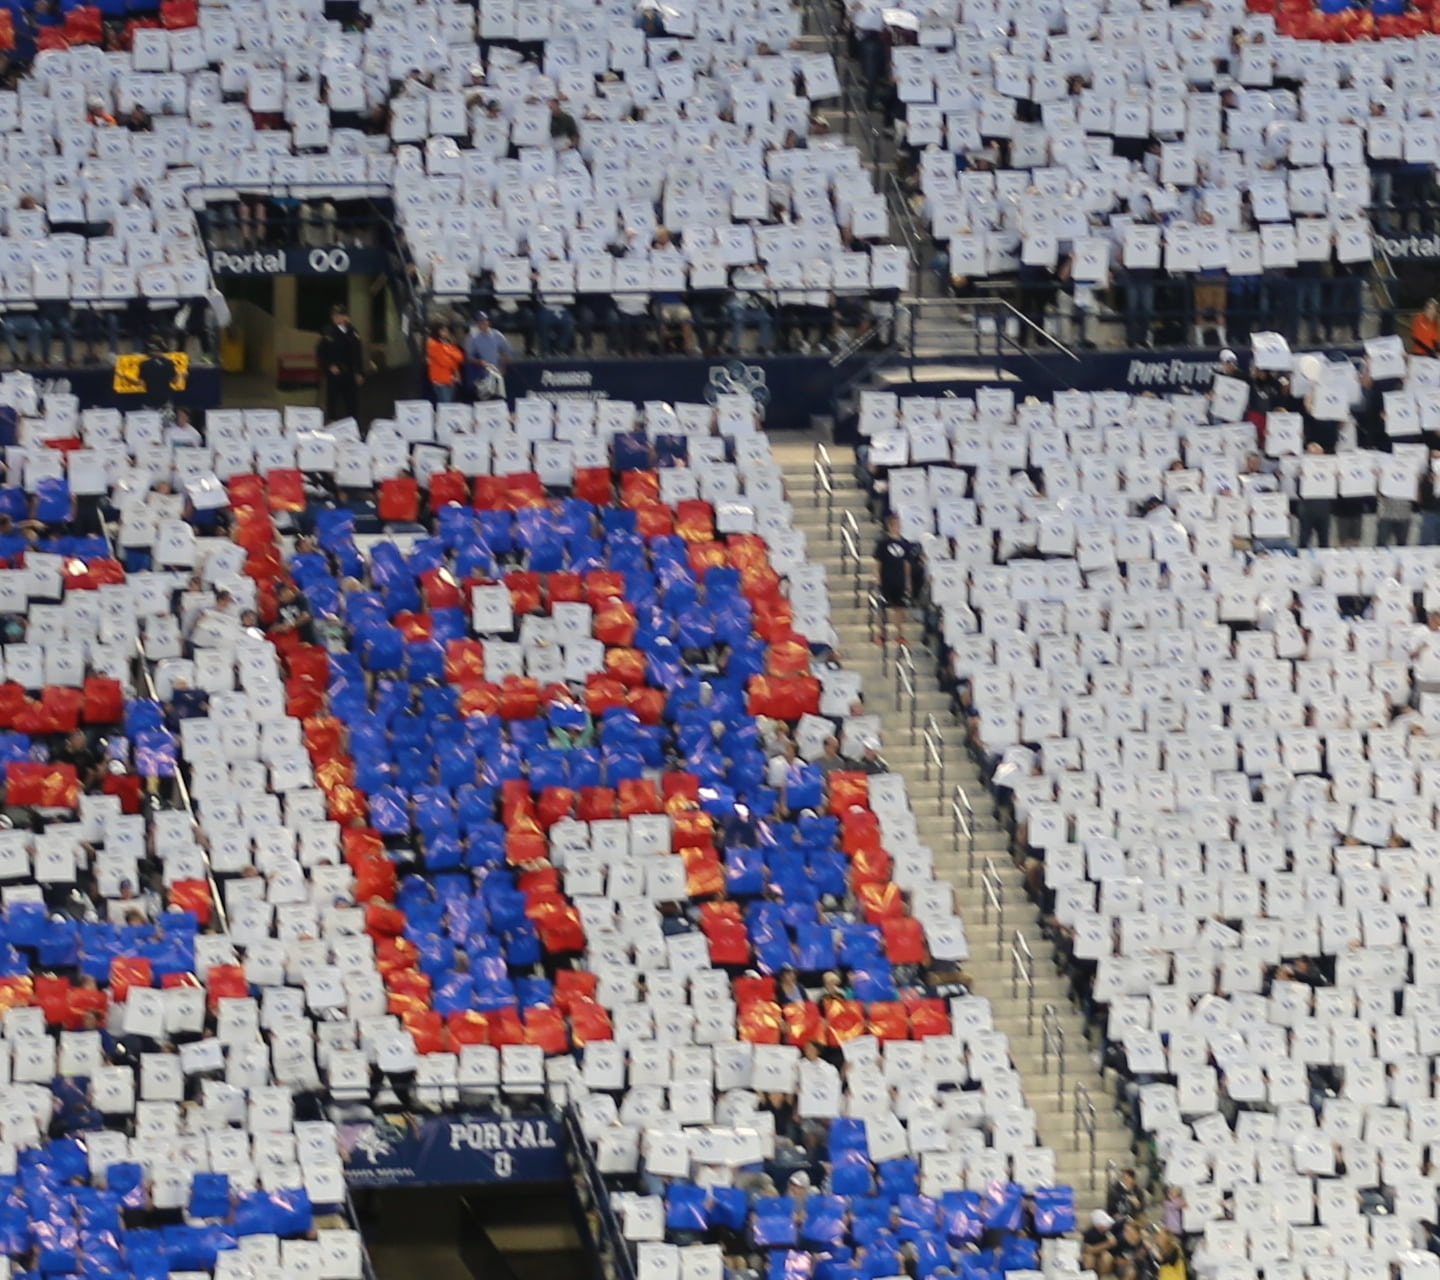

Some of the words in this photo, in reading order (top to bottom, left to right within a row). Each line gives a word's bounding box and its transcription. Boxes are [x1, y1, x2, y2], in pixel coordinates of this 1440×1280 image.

[212, 249, 287, 274] Portal
[308, 248, 351, 273] OO
[449, 1120, 556, 1151] PORTAL
